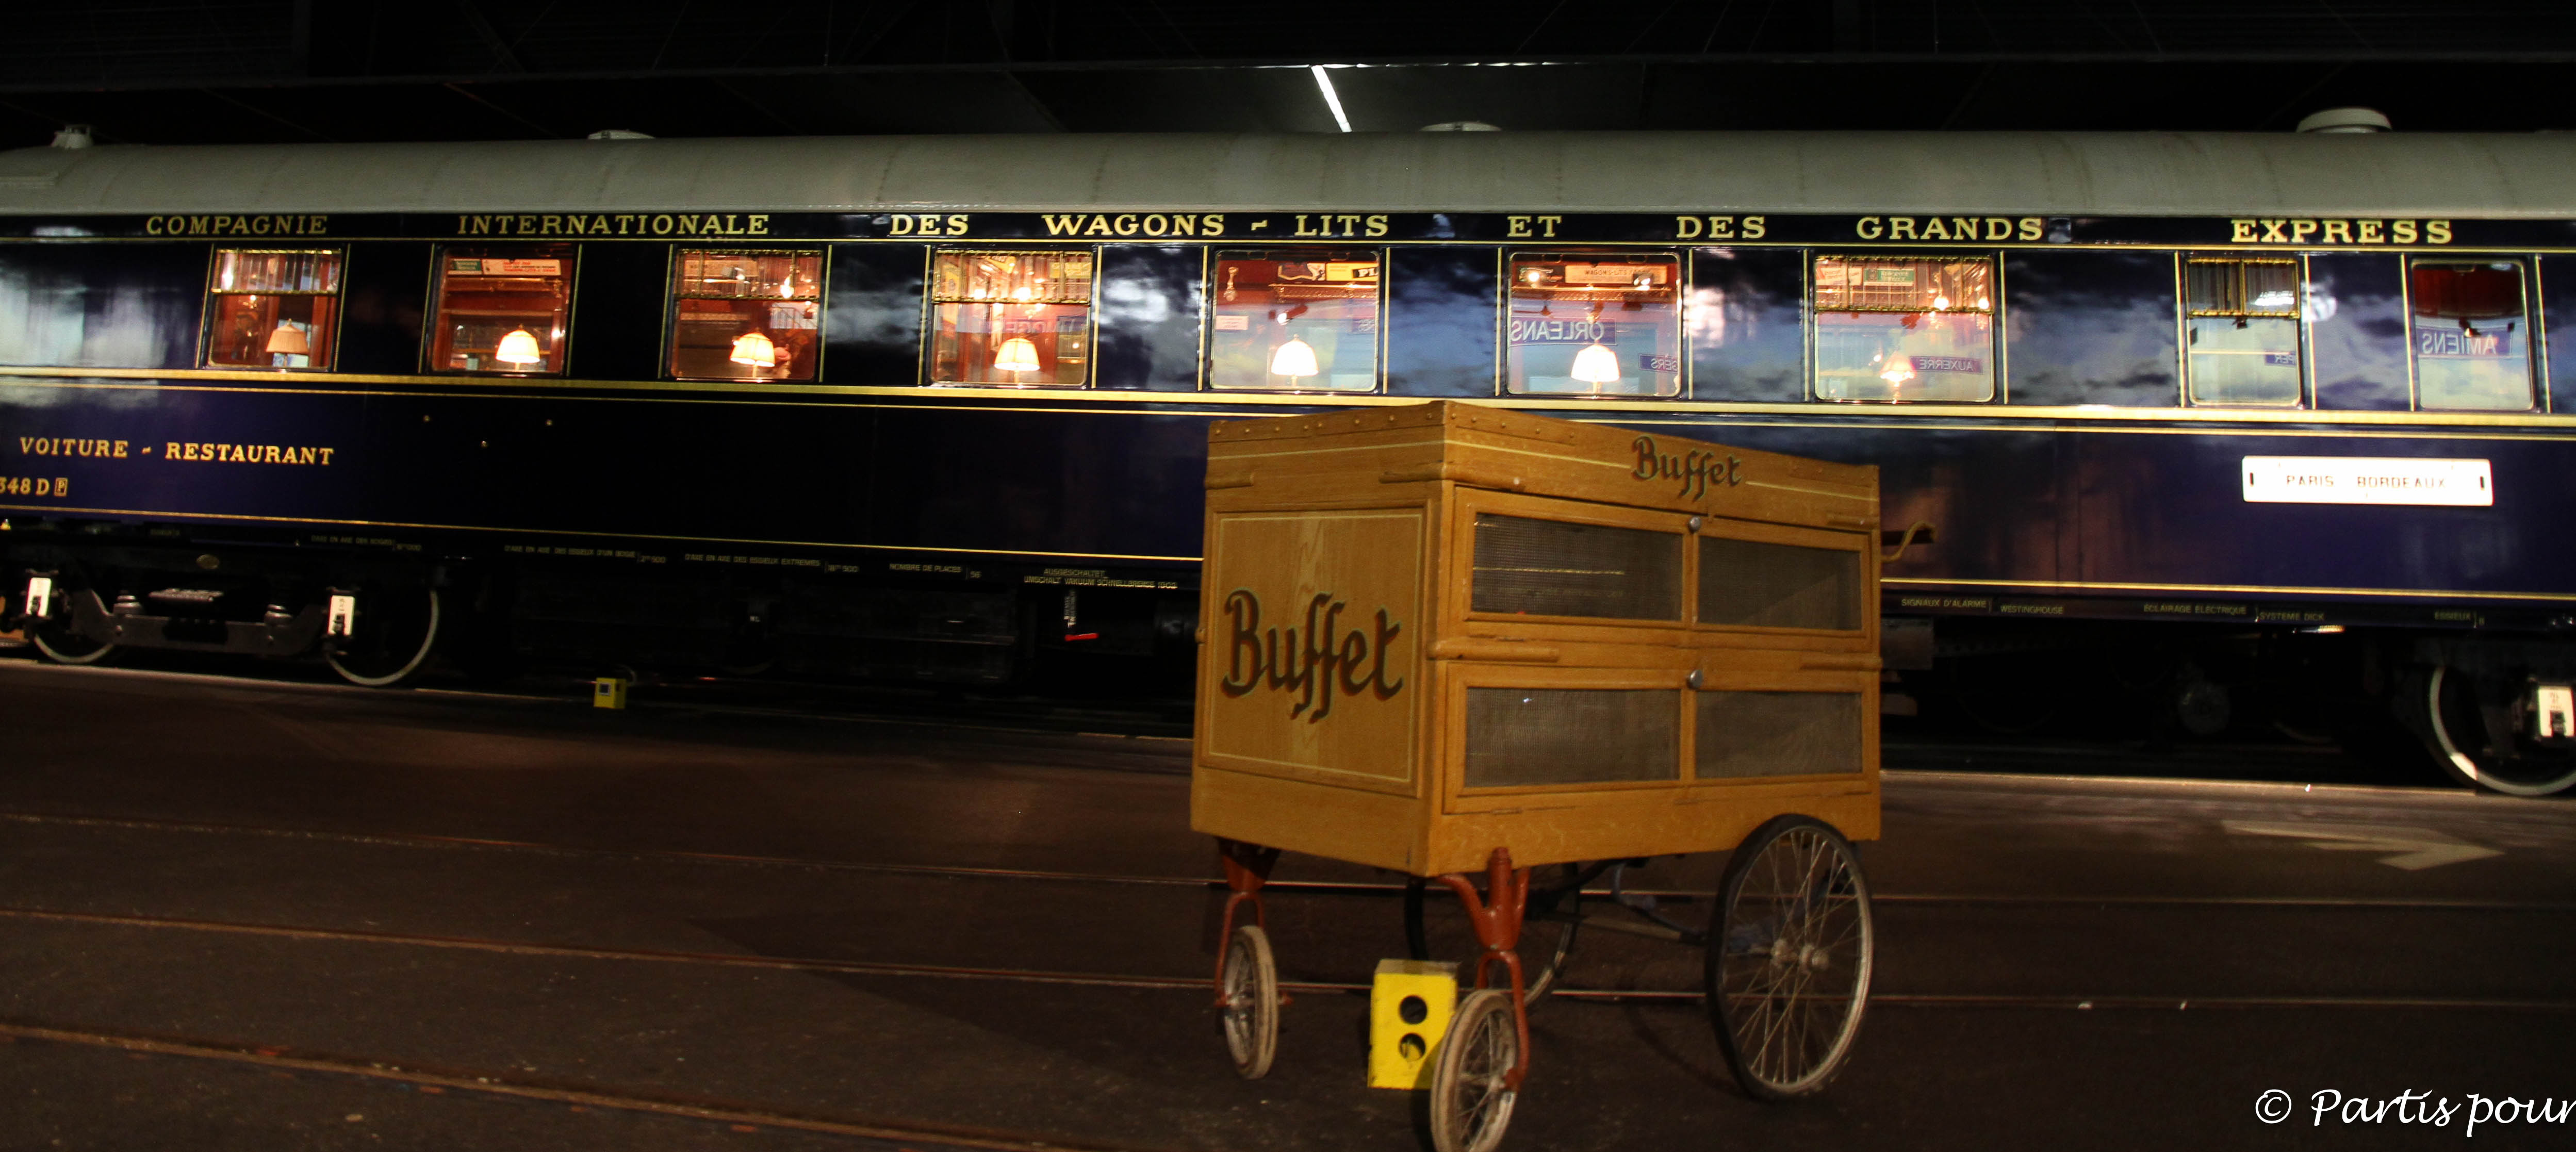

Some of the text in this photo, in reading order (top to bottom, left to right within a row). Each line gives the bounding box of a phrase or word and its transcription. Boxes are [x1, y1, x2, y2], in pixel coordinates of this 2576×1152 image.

[146, 215, 328, 235] COMPAGNIE
[457, 214, 769, 235] INTERNATIONALE
[890, 214, 969, 236] DES
[1041, 214, 1224, 236] WAGONS
[1293, 214, 1389, 237] LITS
[1507, 216, 1562, 238] ET
[1676, 216, 1766, 239] DES
[1856, 217, 2043, 241] GRANDS
[2230, 219, 2452, 244] EXPRESS
[21, 437, 129, 458] VOITURE
[165, 442, 334, 466] RESTAURANT
[1631, 435, 1742, 503] Buffet
[2287, 475, 2447, 489] PARIS BORDEAUX
[35, 478, 51, 497] D
[1901, 599, 1940, 607] SIGNAUX
[1943, 599, 1987, 608] D'ALARME
[1221, 586, 1404, 724] Buffet
